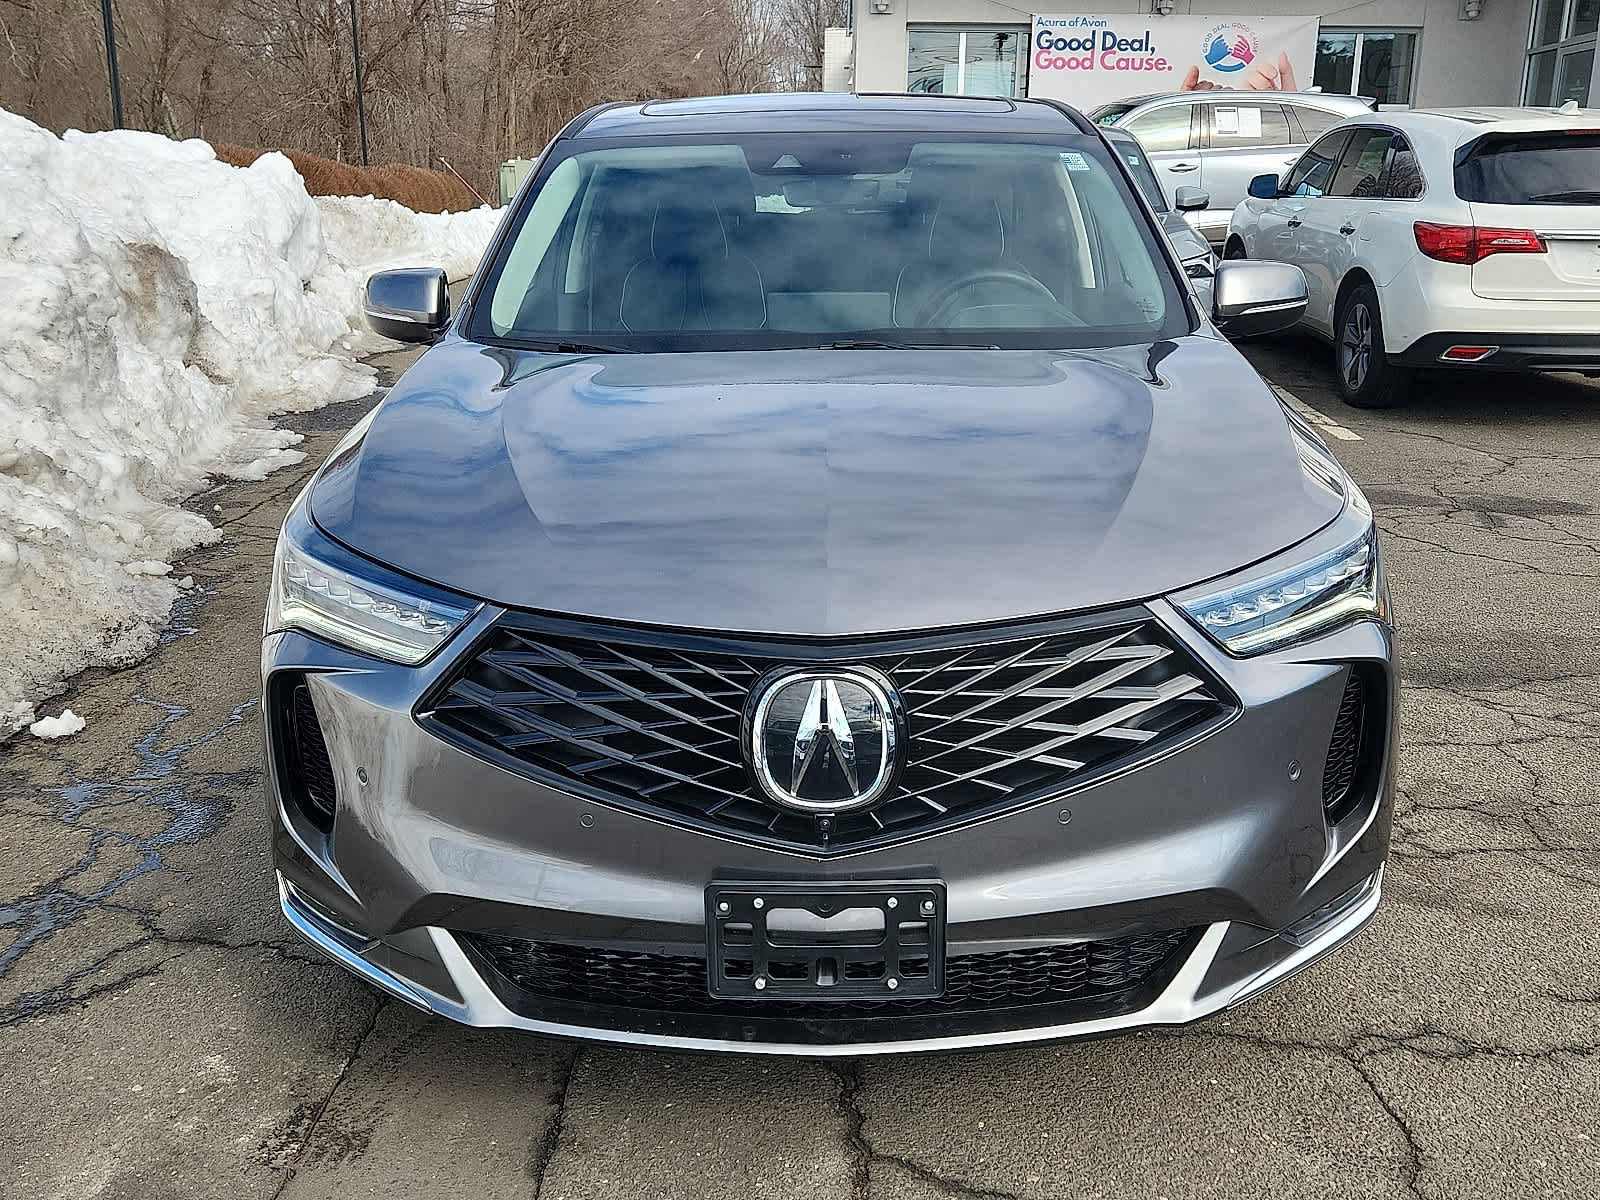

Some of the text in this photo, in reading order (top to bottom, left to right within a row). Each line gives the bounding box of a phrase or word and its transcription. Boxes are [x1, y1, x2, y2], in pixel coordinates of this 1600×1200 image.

[1036, 16, 1107, 28] Acura of Avon
[1036, 30, 1155, 55] Good Deal,
[1035, 49, 1173, 72] Good Cause.
